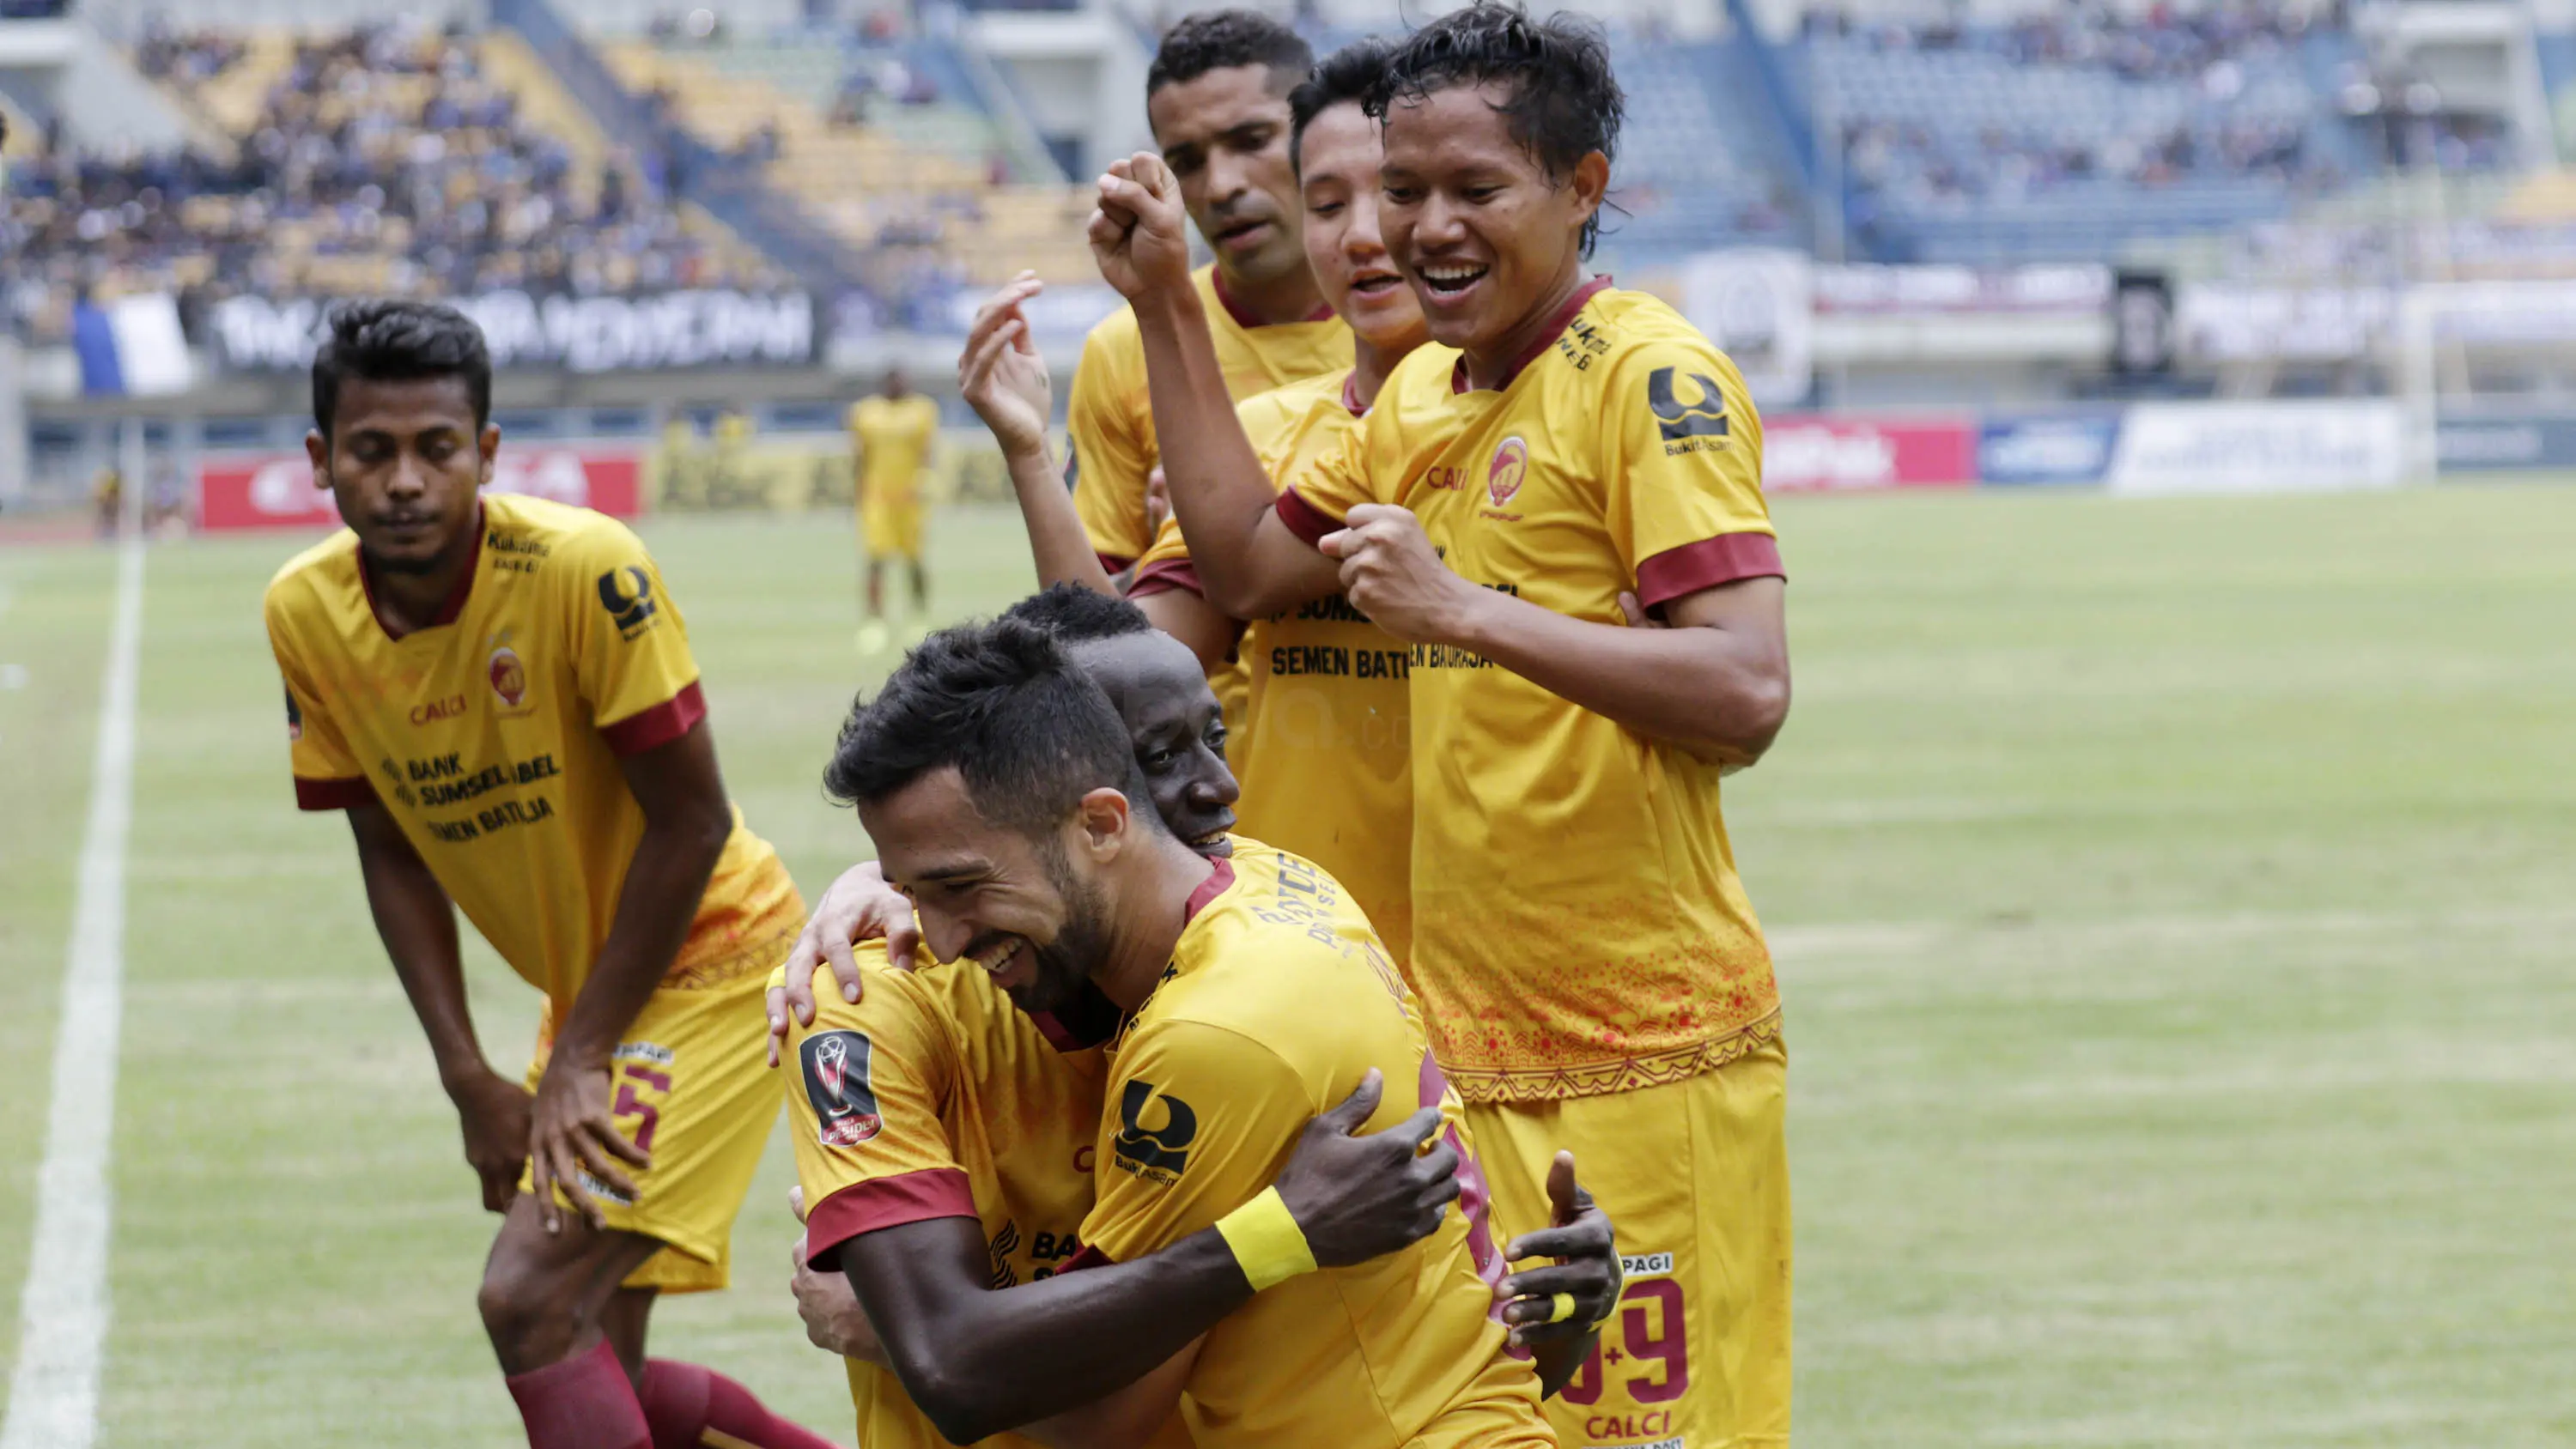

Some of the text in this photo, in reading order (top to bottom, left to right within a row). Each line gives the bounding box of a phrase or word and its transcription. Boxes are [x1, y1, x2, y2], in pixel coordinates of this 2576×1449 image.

[1272, 646, 1349, 676] SEMEN
[408, 751, 465, 780] BANK
[1622, 1255, 1669, 1272] PAGI
[1586, 1411, 1672, 1440] CALCI
